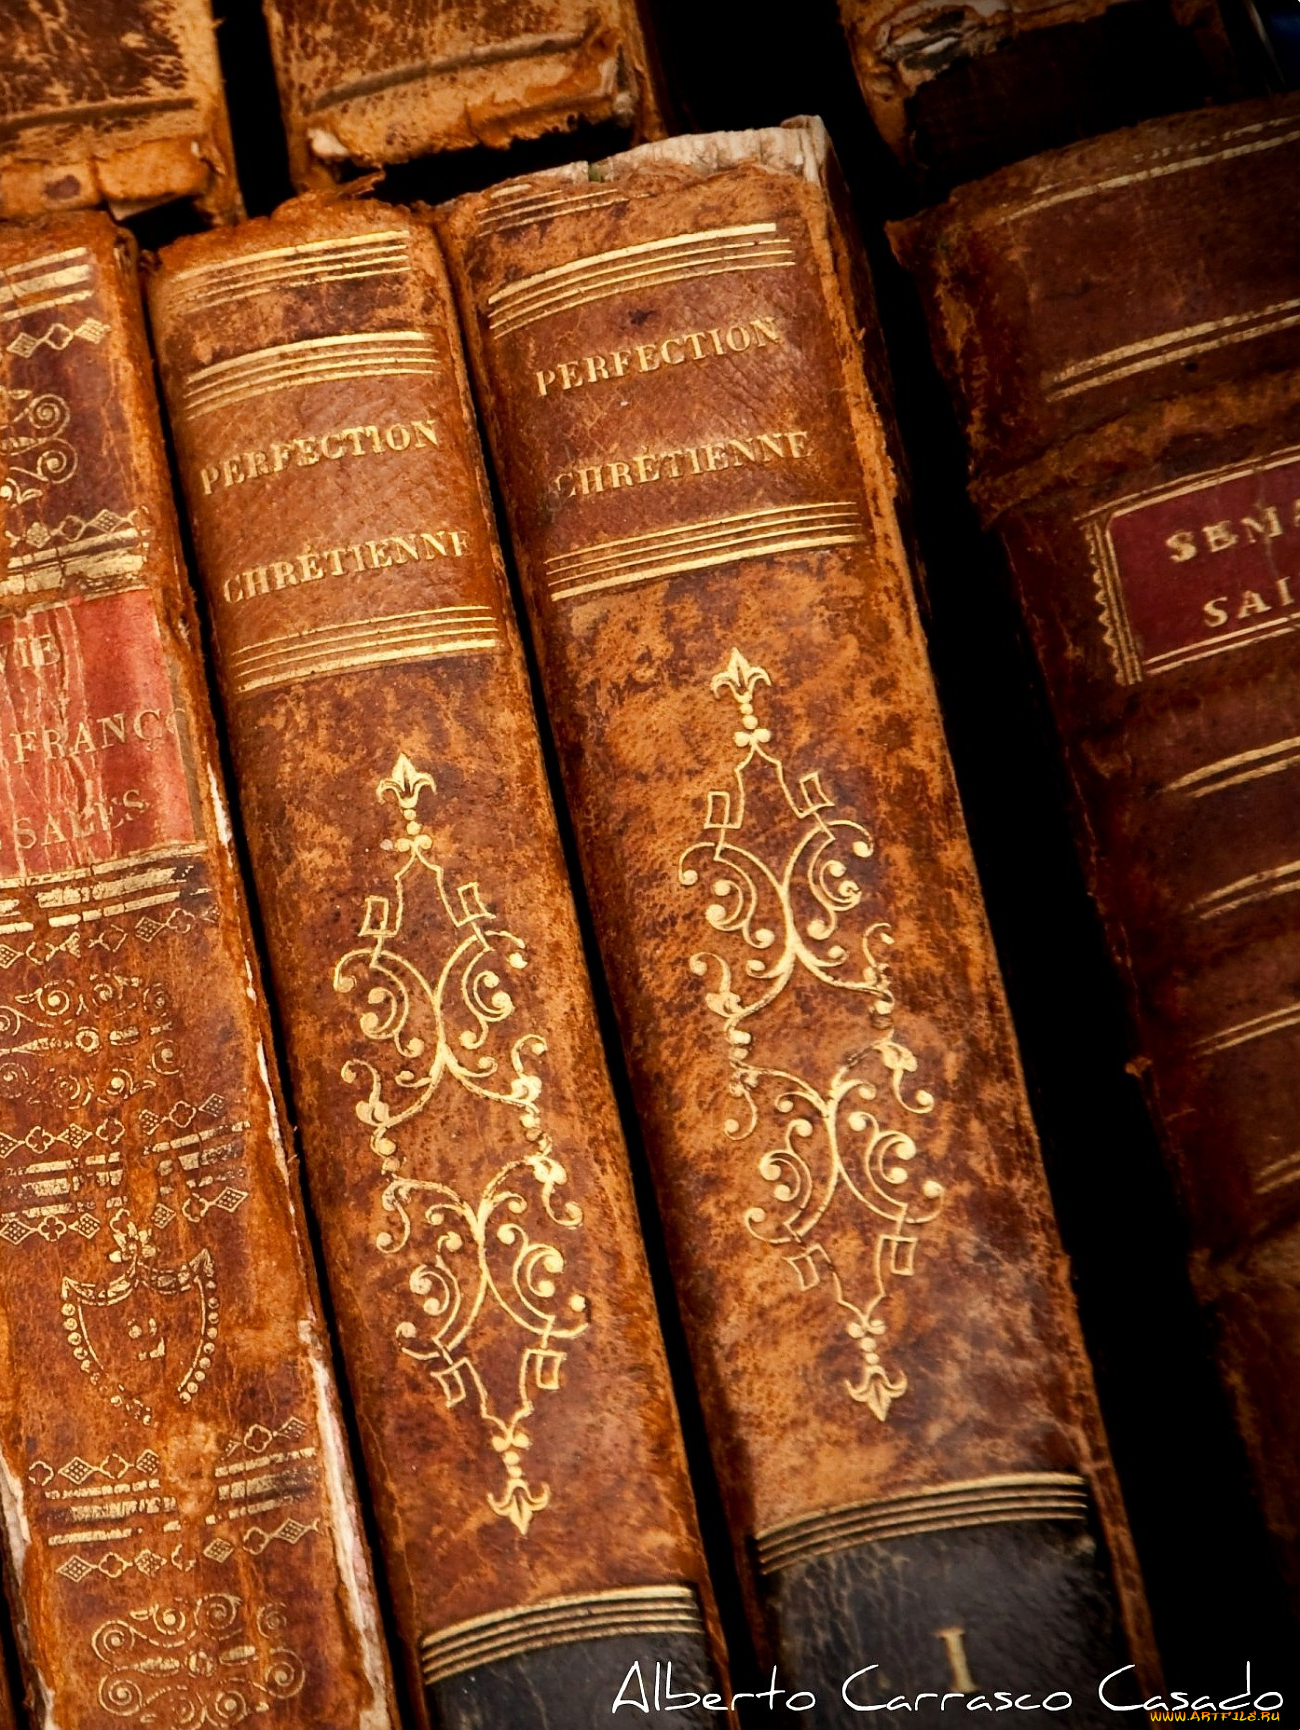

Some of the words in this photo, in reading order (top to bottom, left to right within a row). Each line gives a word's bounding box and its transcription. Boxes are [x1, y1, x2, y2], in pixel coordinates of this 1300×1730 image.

[536, 316, 782, 397] PERFECTION
[201, 418, 440, 496] PERFECTION
[1203, 576, 1295, 628] SAI
